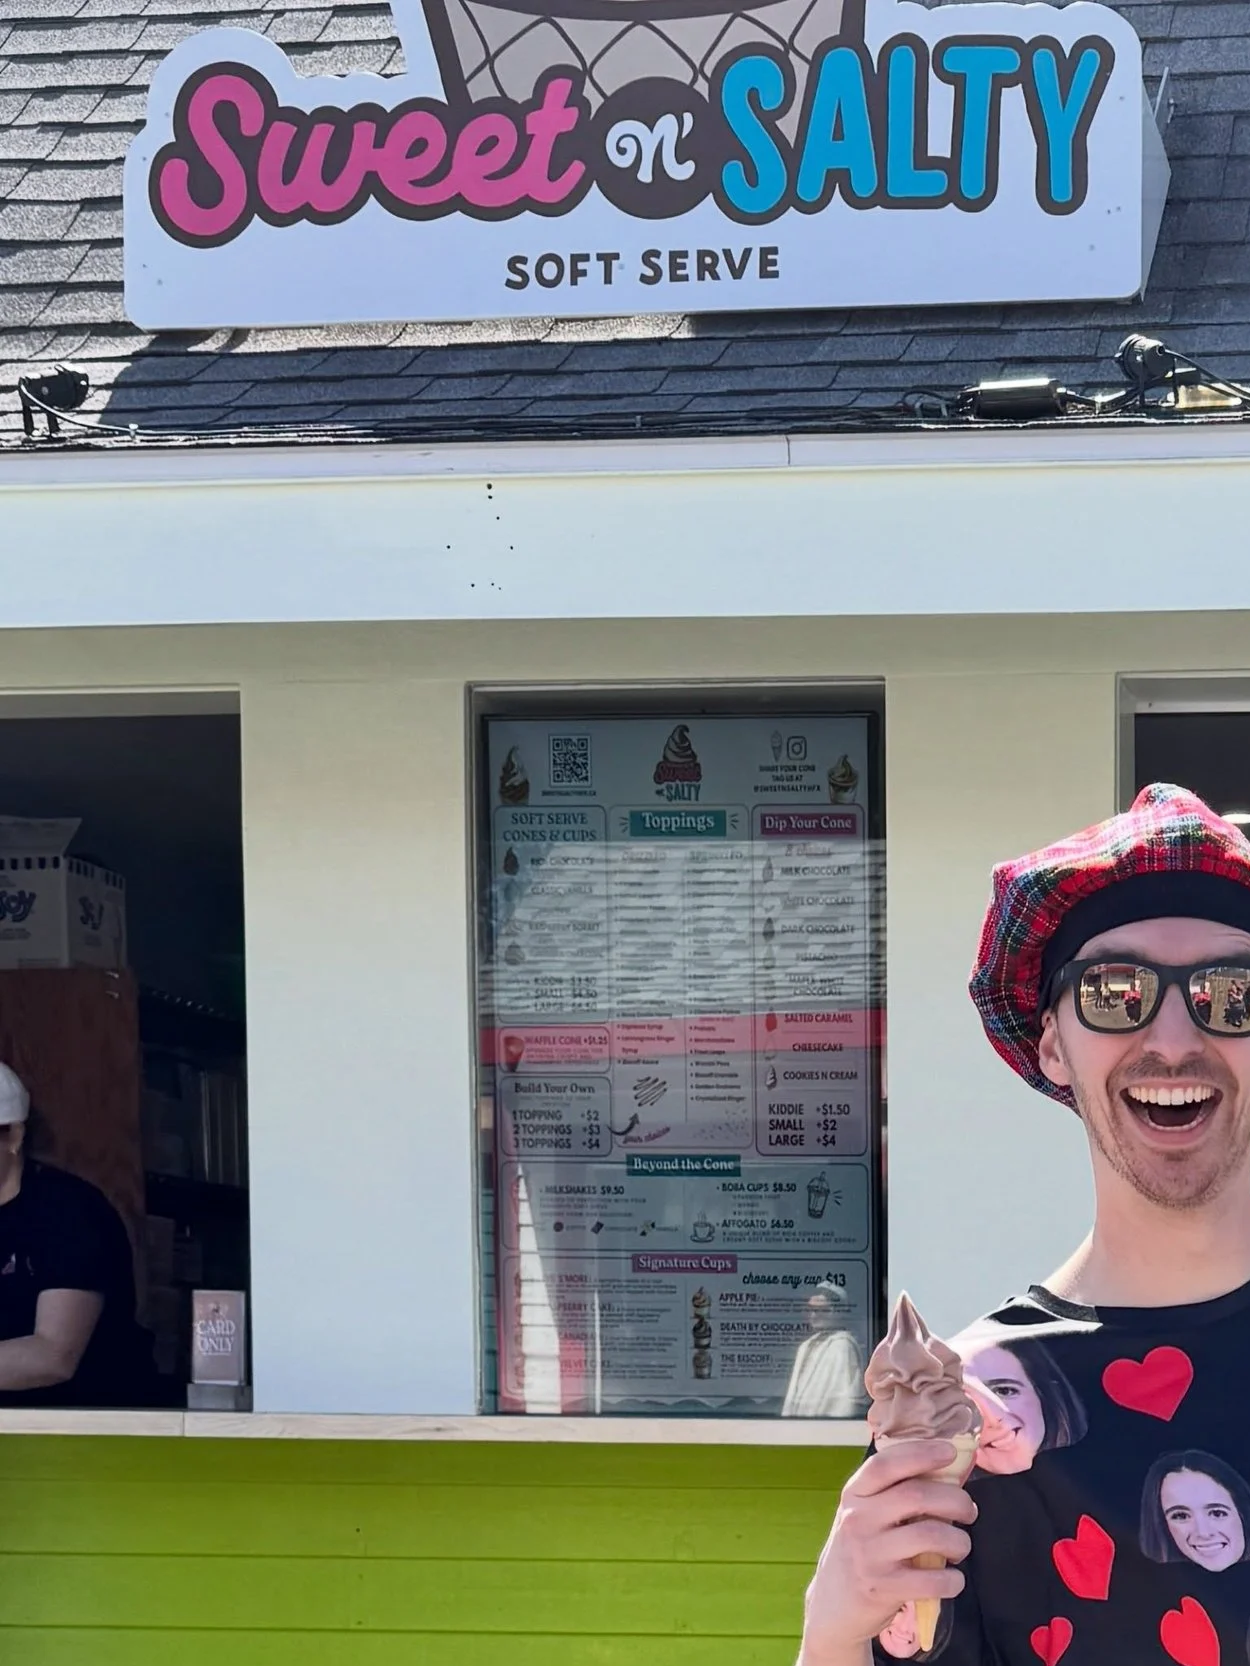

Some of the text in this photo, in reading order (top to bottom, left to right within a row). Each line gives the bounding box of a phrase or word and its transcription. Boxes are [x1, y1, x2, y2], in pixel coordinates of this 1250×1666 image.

[154, 68, 590, 240] Sweet
[719, 45, 1102, 215] SALTY
[503, 246, 782, 291] SOFT SERVE
[666, 784, 701, 801] SALTY
[511, 813, 589, 825] SOFT SERVE
[641, 811, 715, 831] Toppings
[765, 816, 852, 830] Dip Your Cone
[503, 830, 598, 842] CONES & CUPS
[802, 866, 852, 876] CHOCOLATE
[806, 925, 855, 934] CHOCOLATE
[784, 1013, 853, 1023] SALTED CARAMEL
[559, 1036, 582, 1046] CONE
[792, 1043, 843, 1052] CHEESECAKE
[783, 1071, 858, 1080] COOKIES N CREAM
[514, 1083, 596, 1094] Build Your Own
[768, 1104, 804, 1115] KIDDIE
[519, 1110, 562, 1121] TOPPING
[512, 1124, 520, 1135] 2
[521, 1124, 572, 1135] TOPPINGS
[768, 1119, 805, 1131] SMALL
[521, 1138, 572, 1149] TOPPINGS
[768, 1134, 805, 1146] LARGE
[633, 1157, 735, 1172] Beyond the Cone
[544, 1184, 625, 1195] MILKSHAKES $9.50
[721, 1182, 797, 1193] BOBA CUPS $8.50
[721, 1219, 794, 1229] AFFOGATO $6.50
[639, 1256, 732, 1271] Signature Cups
[742, 1272, 780, 1286] choose
[781, 1275, 802, 1289] any
[826, 1271, 846, 1287] $13
[719, 1293, 744, 1302] APPLE
[197, 1320, 236, 1335] CARD
[720, 1323, 747, 1332] DEATH
[748, 1323, 759, 1332] BY
[199, 1337, 234, 1352] ONLY
[721, 1354, 737, 1363] THE
